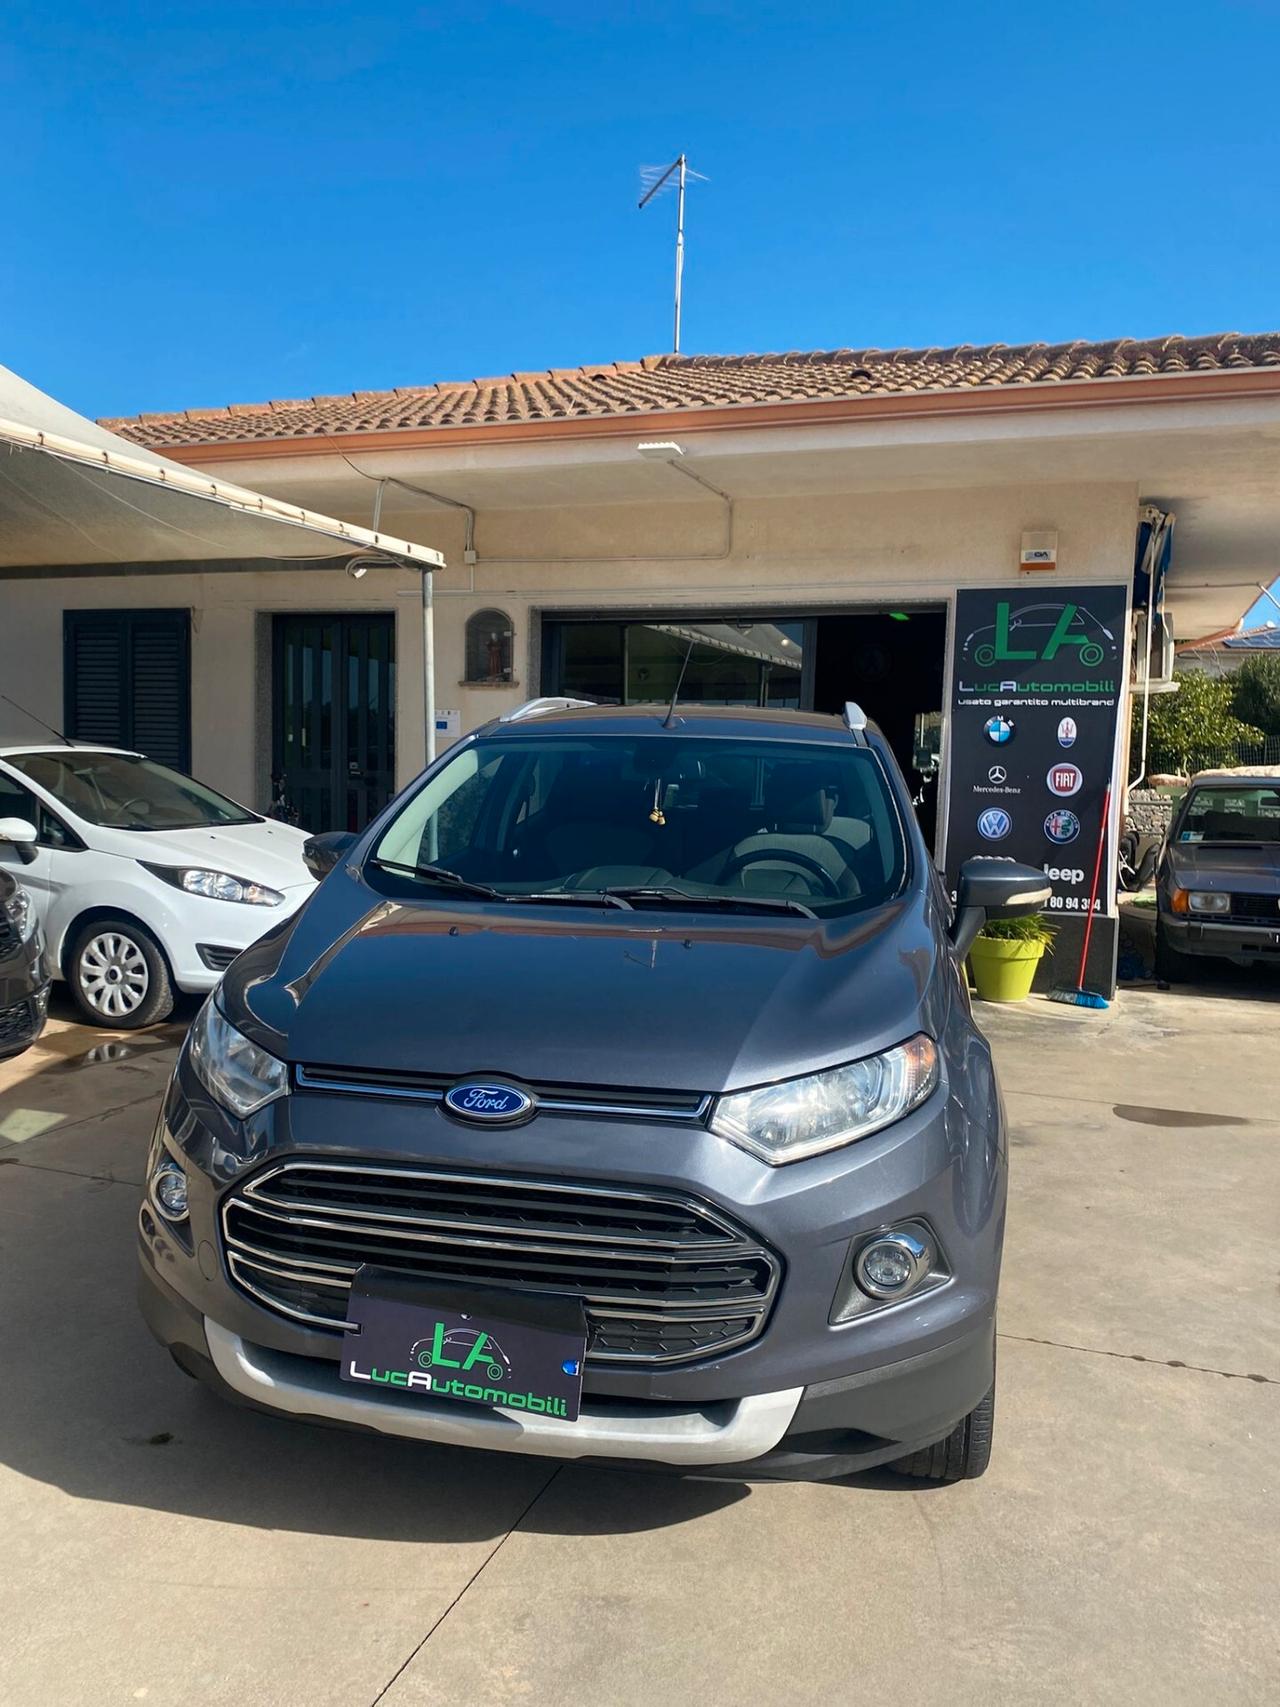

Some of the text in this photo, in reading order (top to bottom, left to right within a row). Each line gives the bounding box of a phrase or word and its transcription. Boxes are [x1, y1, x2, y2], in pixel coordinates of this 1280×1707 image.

[958, 680, 1115, 693] LucAutomobili
[958, 698, 1115, 707] usato garantito multibrand
[1055, 772, 1075, 788] FIAT
[972, 785, 1022, 794] Mercedes-Benz
[1050, 896, 1063, 909] 80
[1065, 897, 1079, 910] 94
[1081, 898, 1101, 911] 34
[463, 1088, 510, 1110] Ford
[350, 1361, 568, 1417] LucAutomobili
